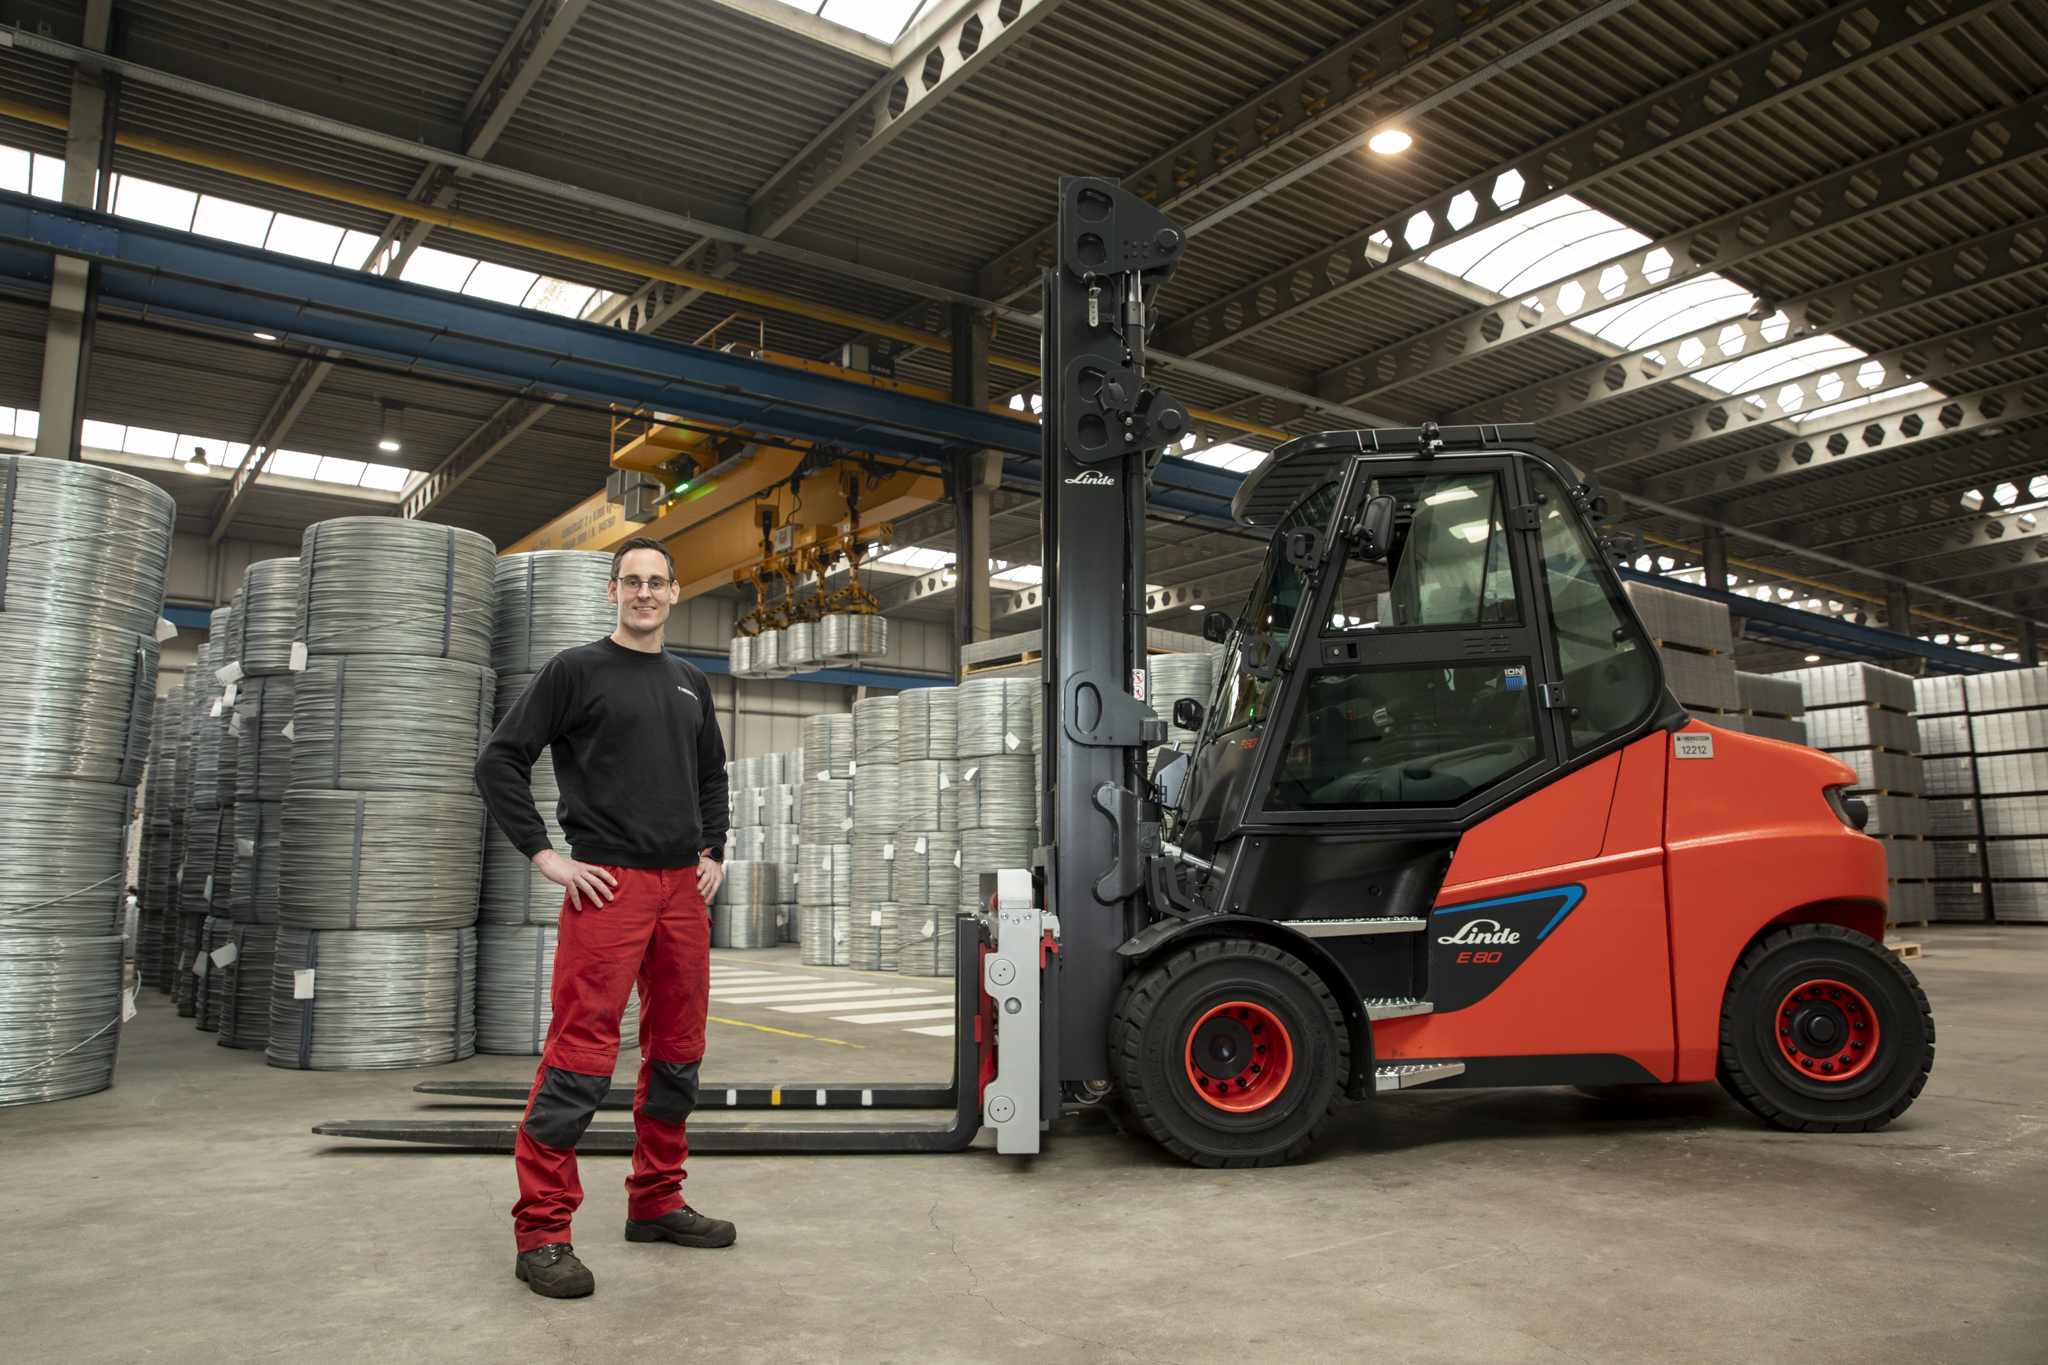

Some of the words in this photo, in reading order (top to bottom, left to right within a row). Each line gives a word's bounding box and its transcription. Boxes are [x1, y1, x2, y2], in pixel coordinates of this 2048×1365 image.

[1064, 470, 1115, 486] Linde
[1681, 745, 1707, 755] 12212
[1437, 919, 1521, 945] Linde
